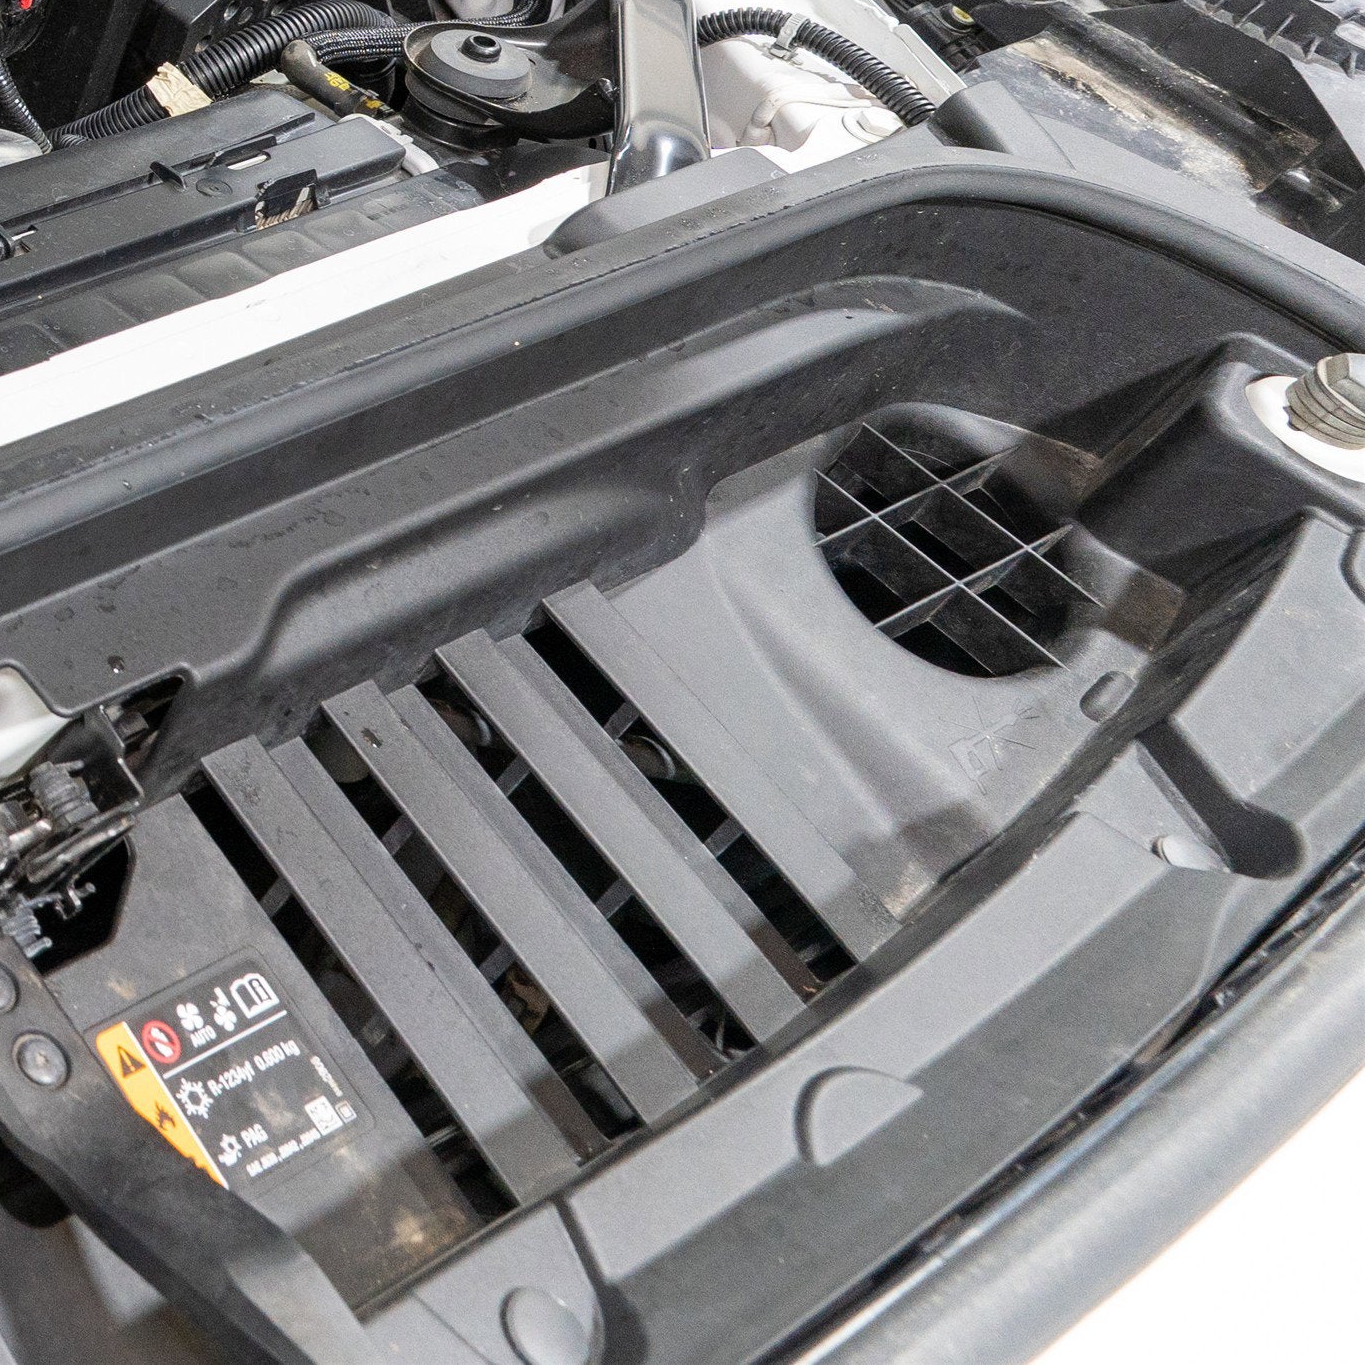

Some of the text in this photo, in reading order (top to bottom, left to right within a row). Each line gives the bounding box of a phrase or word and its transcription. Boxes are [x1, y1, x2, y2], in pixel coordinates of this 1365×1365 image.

[190, 1024, 217, 1048] AUTO
[280, 1040, 301, 1057] kg
[240, 1123, 269, 1149] PAG
